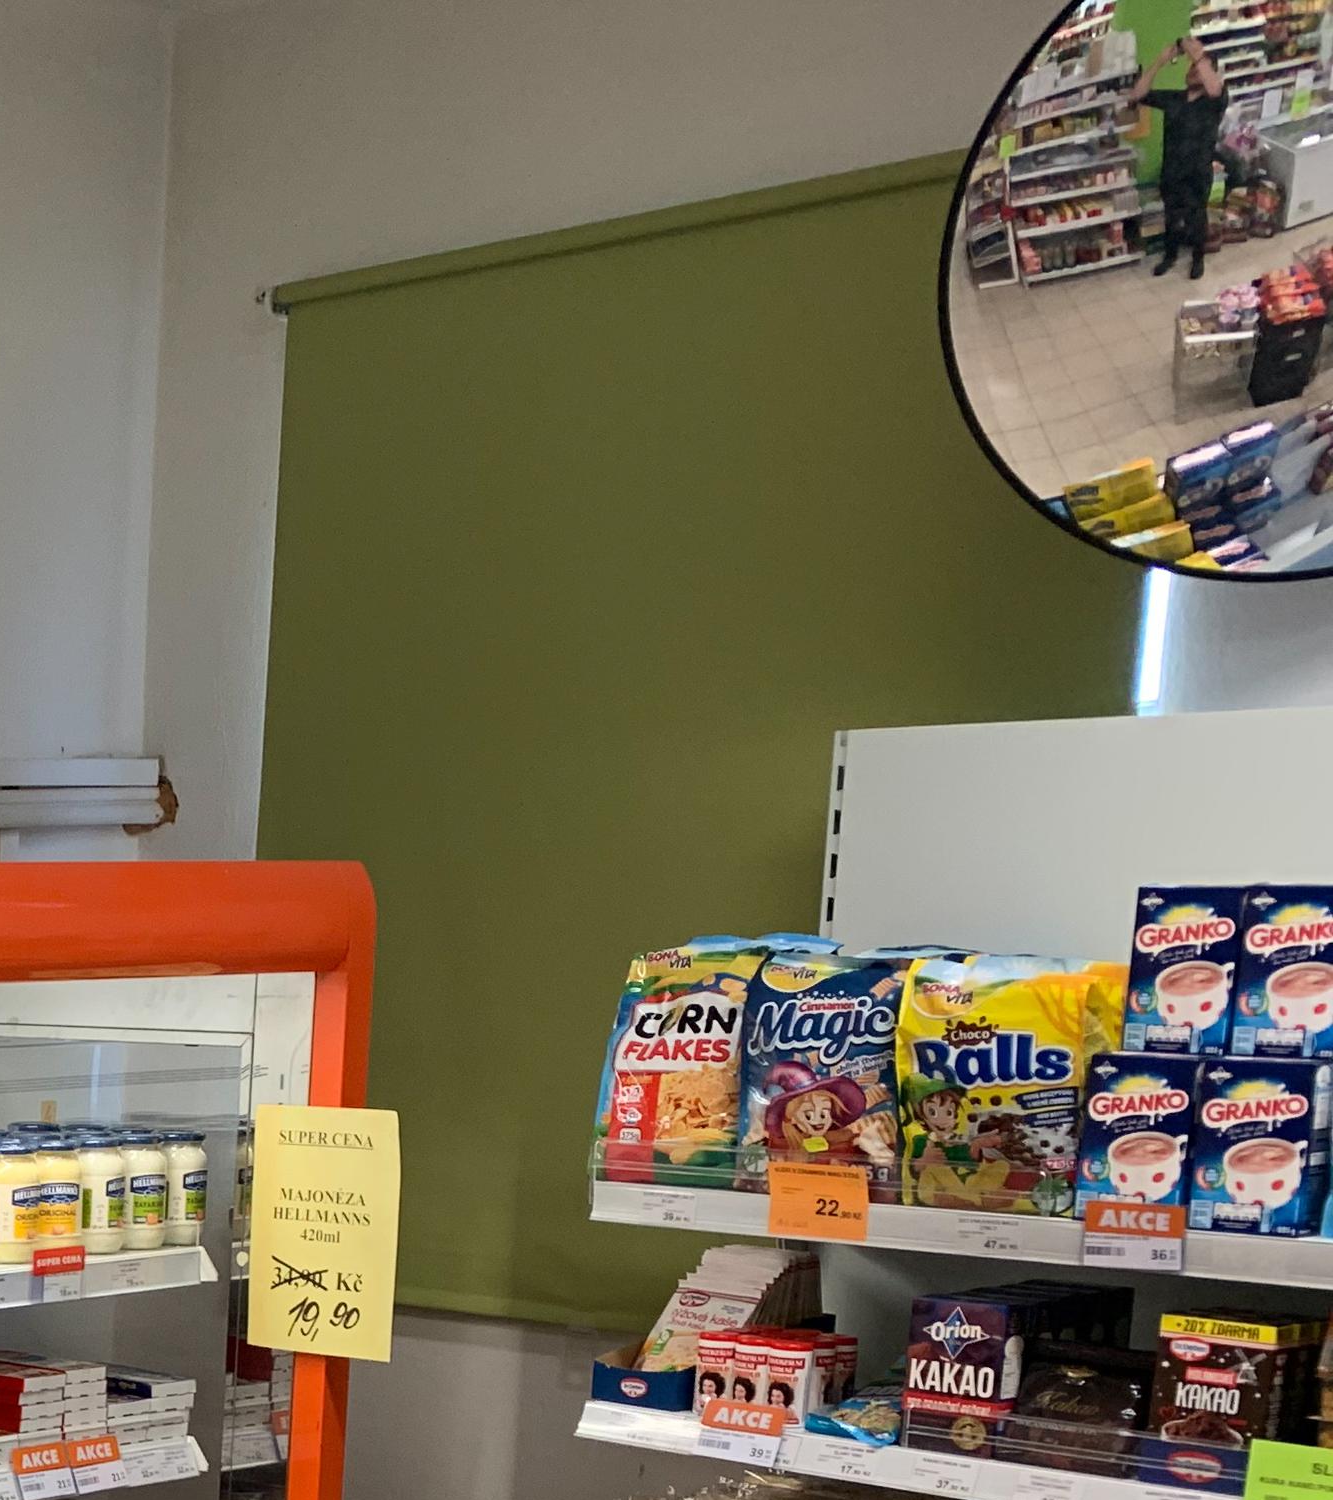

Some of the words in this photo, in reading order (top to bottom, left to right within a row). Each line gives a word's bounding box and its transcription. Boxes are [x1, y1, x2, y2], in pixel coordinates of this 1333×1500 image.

[1138, 919, 1233, 948] GRANKO
[799, 1001, 856, 1013] Cinnamon
[749, 998, 895, 1062] Magic
[951, 1029, 991, 1042] Choco
[623, 1038, 731, 1063] FLAKES
[914, 1033, 1072, 1086] Balls
[1093, 1091, 1186, 1116] GRANKO
[1205, 1096, 1305, 1122] GRANKO
[279, 1129, 328, 1145] SUPER
[332, 1132, 373, 1148] CENA
[280, 1187, 366, 1207] MAJONÉZA
[273, 1207, 371, 1226] HELLMANNS
[1099, 1210, 1171, 1232] AKCE
[300, 1229, 340, 1243] 420ml
[36, 1258, 59, 1269] SUPER
[61, 1254, 84, 1266] CENA
[337, 1272, 363, 1293] Kč
[932, 1320, 983, 1342] Orion
[908, 1357, 996, 1399] KAKAO
[1175, 1382, 1240, 1416] KAKAO
[713, 1406, 774, 1431] AKCE
[20, 1448, 60, 1469] AKCE
[75, 1441, 114, 1463] AKCE
